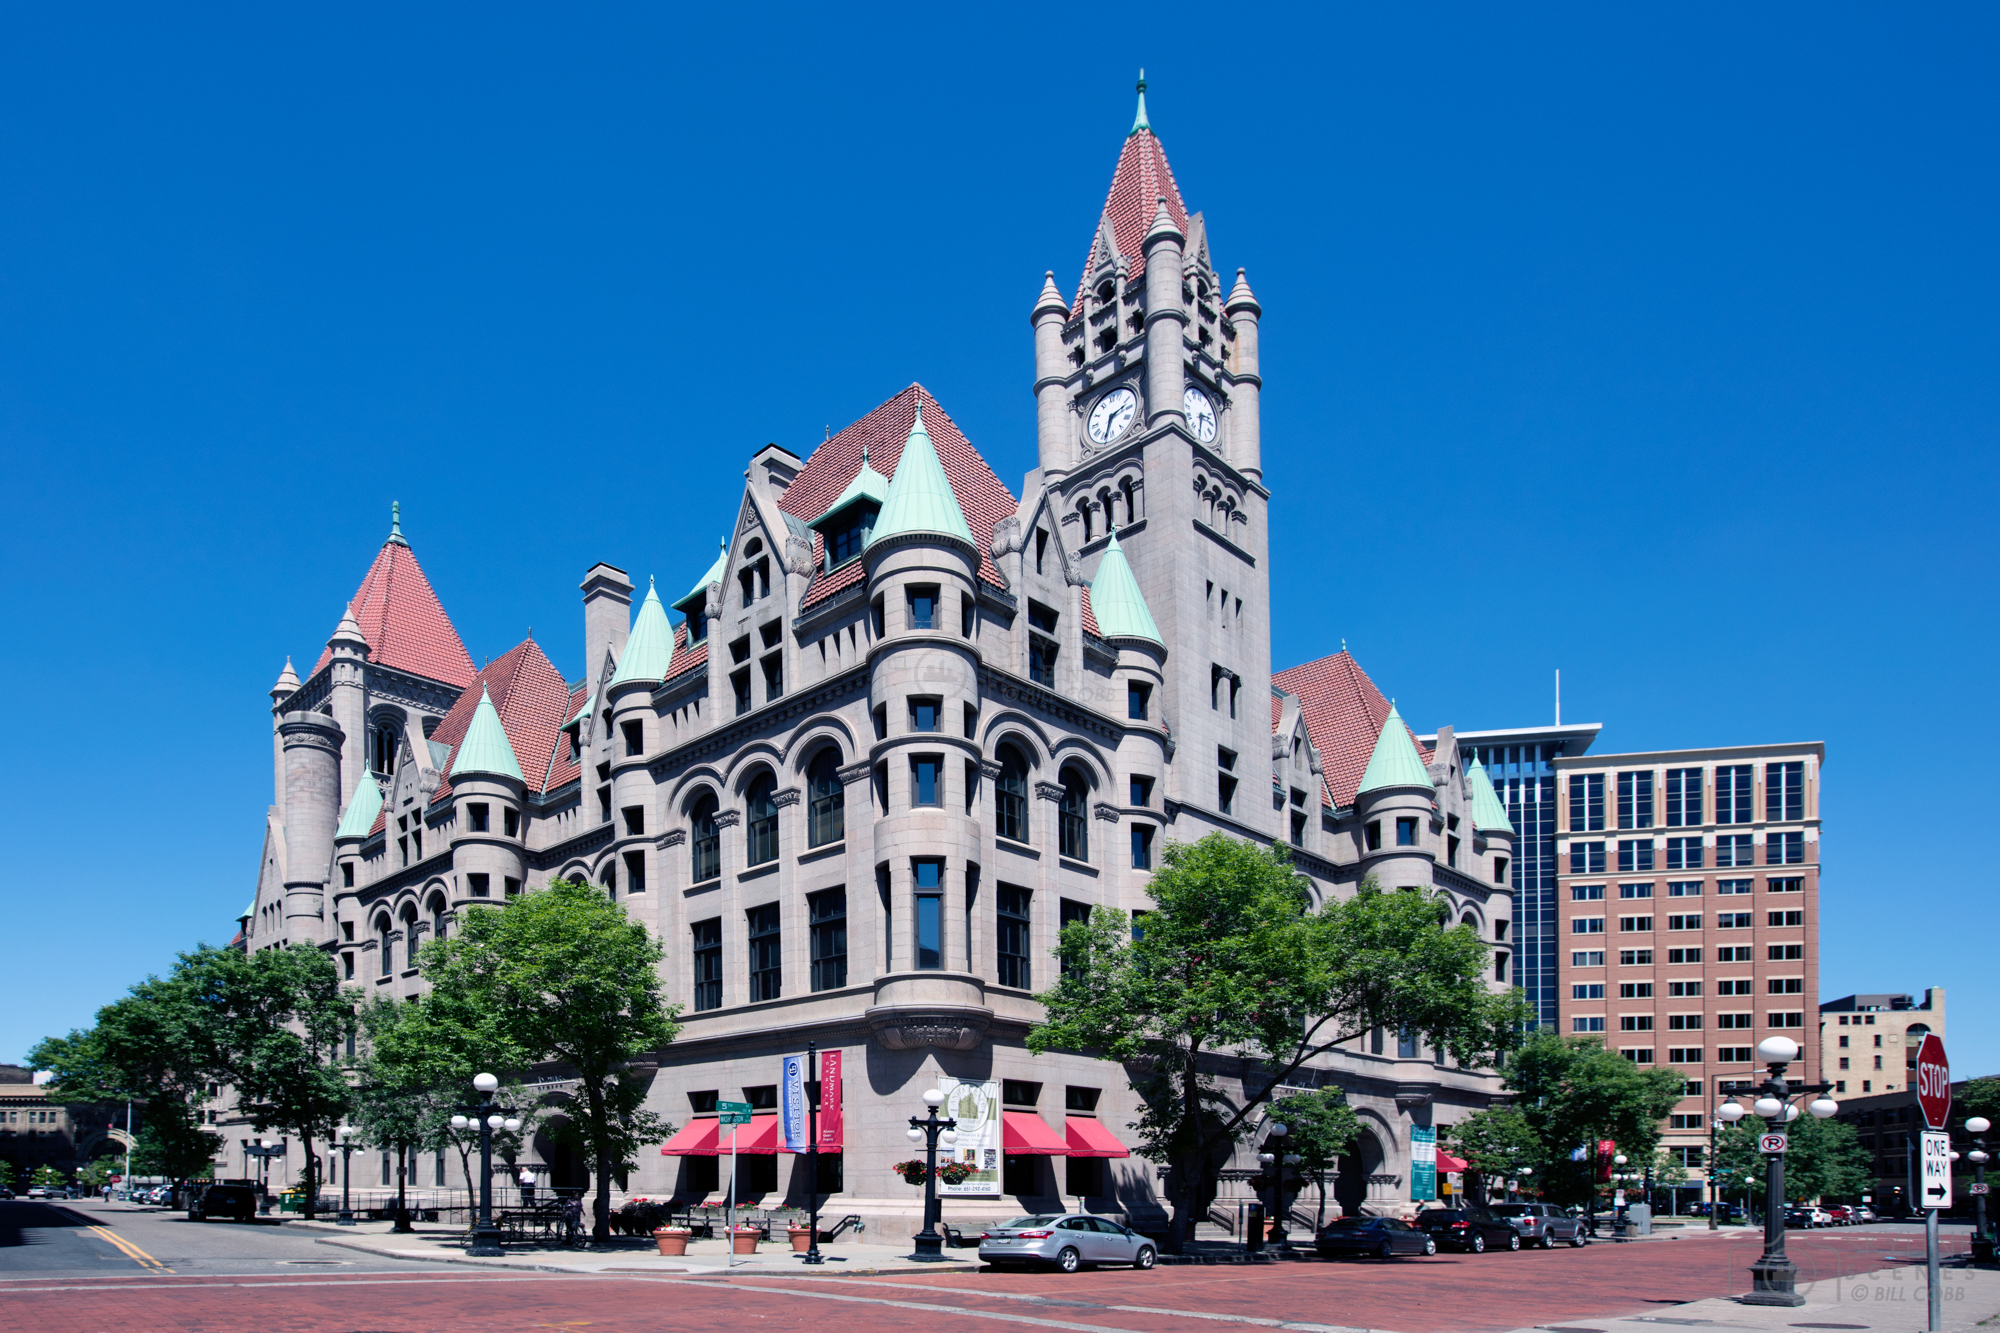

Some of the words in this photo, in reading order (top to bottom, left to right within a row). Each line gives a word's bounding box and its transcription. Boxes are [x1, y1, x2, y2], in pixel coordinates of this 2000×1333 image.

[829, 1054, 837, 1110] LANDMARK
[1920, 1062, 1948, 1099] STOP
[792, 1079, 801, 1140] VISITOR
[1926, 1139, 1946, 1157] ONE
[1926, 1159, 1947, 1178] WAY
